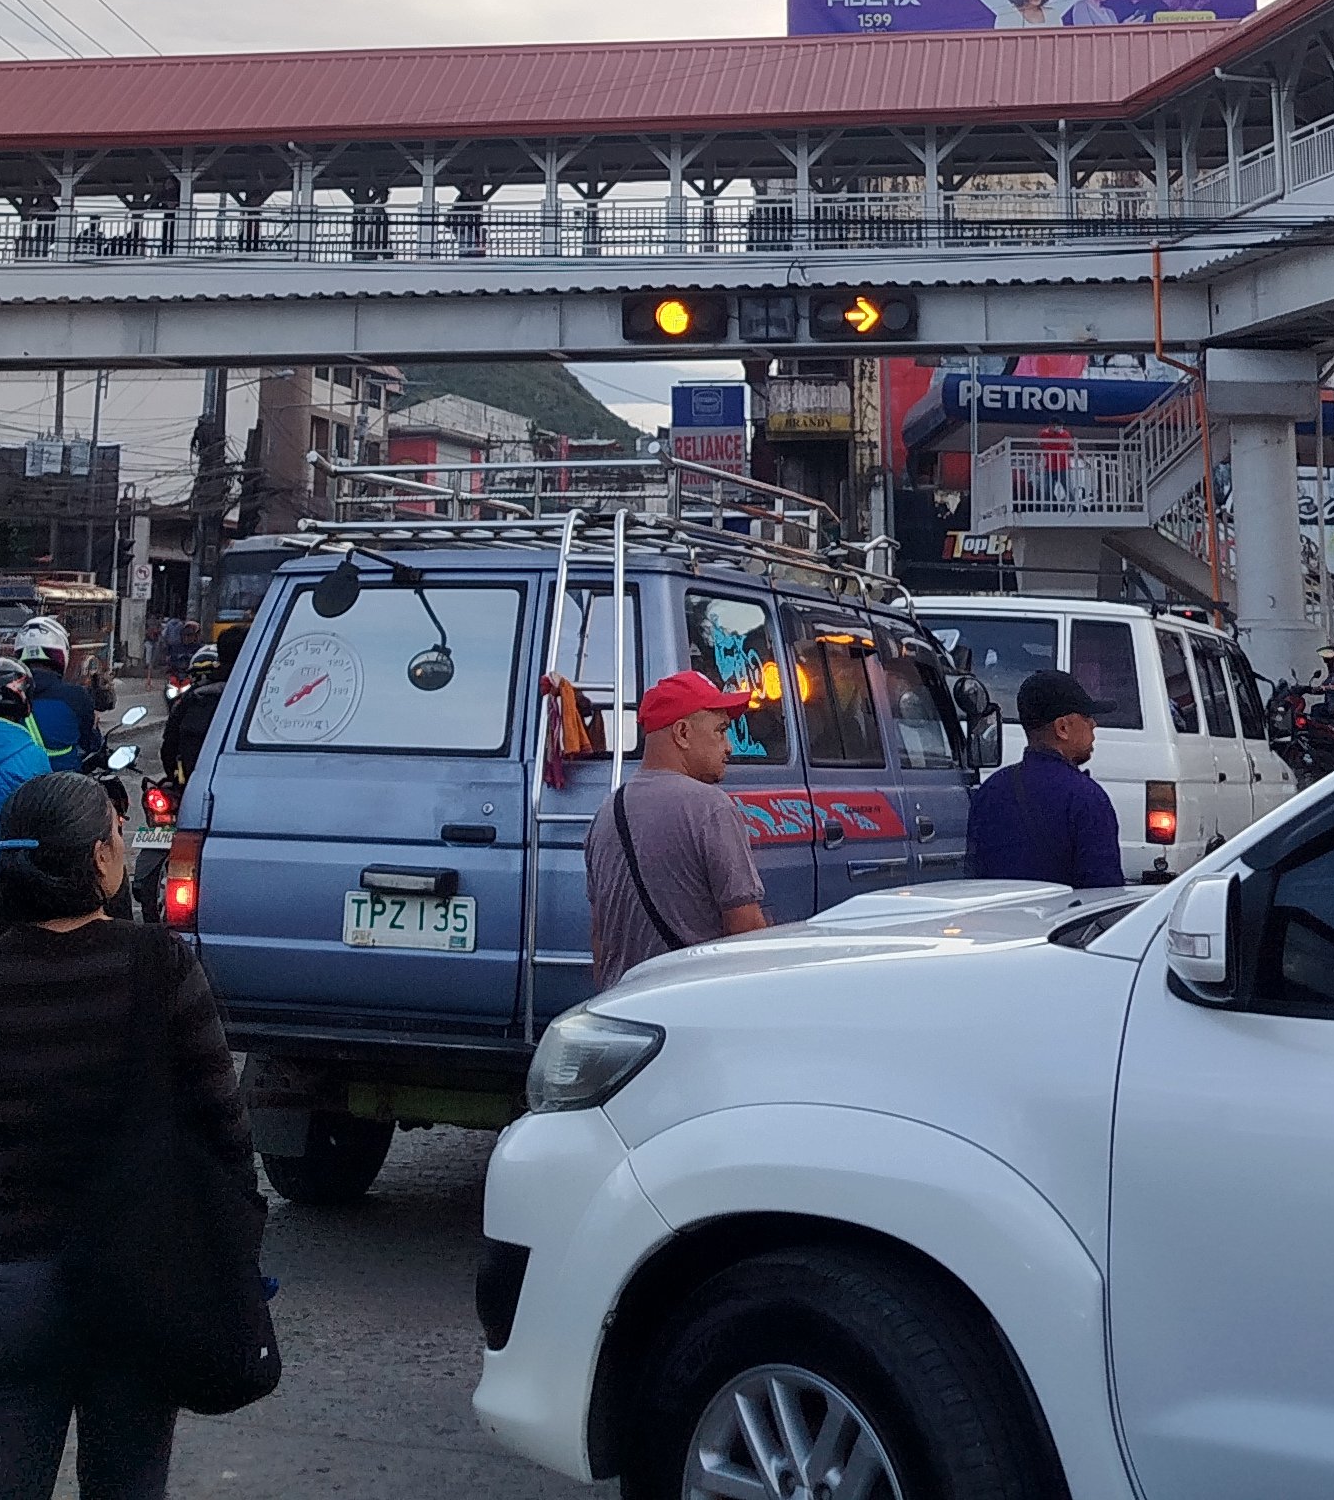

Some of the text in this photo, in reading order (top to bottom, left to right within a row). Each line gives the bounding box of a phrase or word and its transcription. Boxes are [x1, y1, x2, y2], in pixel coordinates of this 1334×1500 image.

[857, 13, 892, 27] 1599
[958, 380, 1088, 412] PETRON
[784, 417, 832, 429] BRANDY
[674, 435, 742, 461] RELIANCE
[351, 898, 468, 933] TPZ 135
